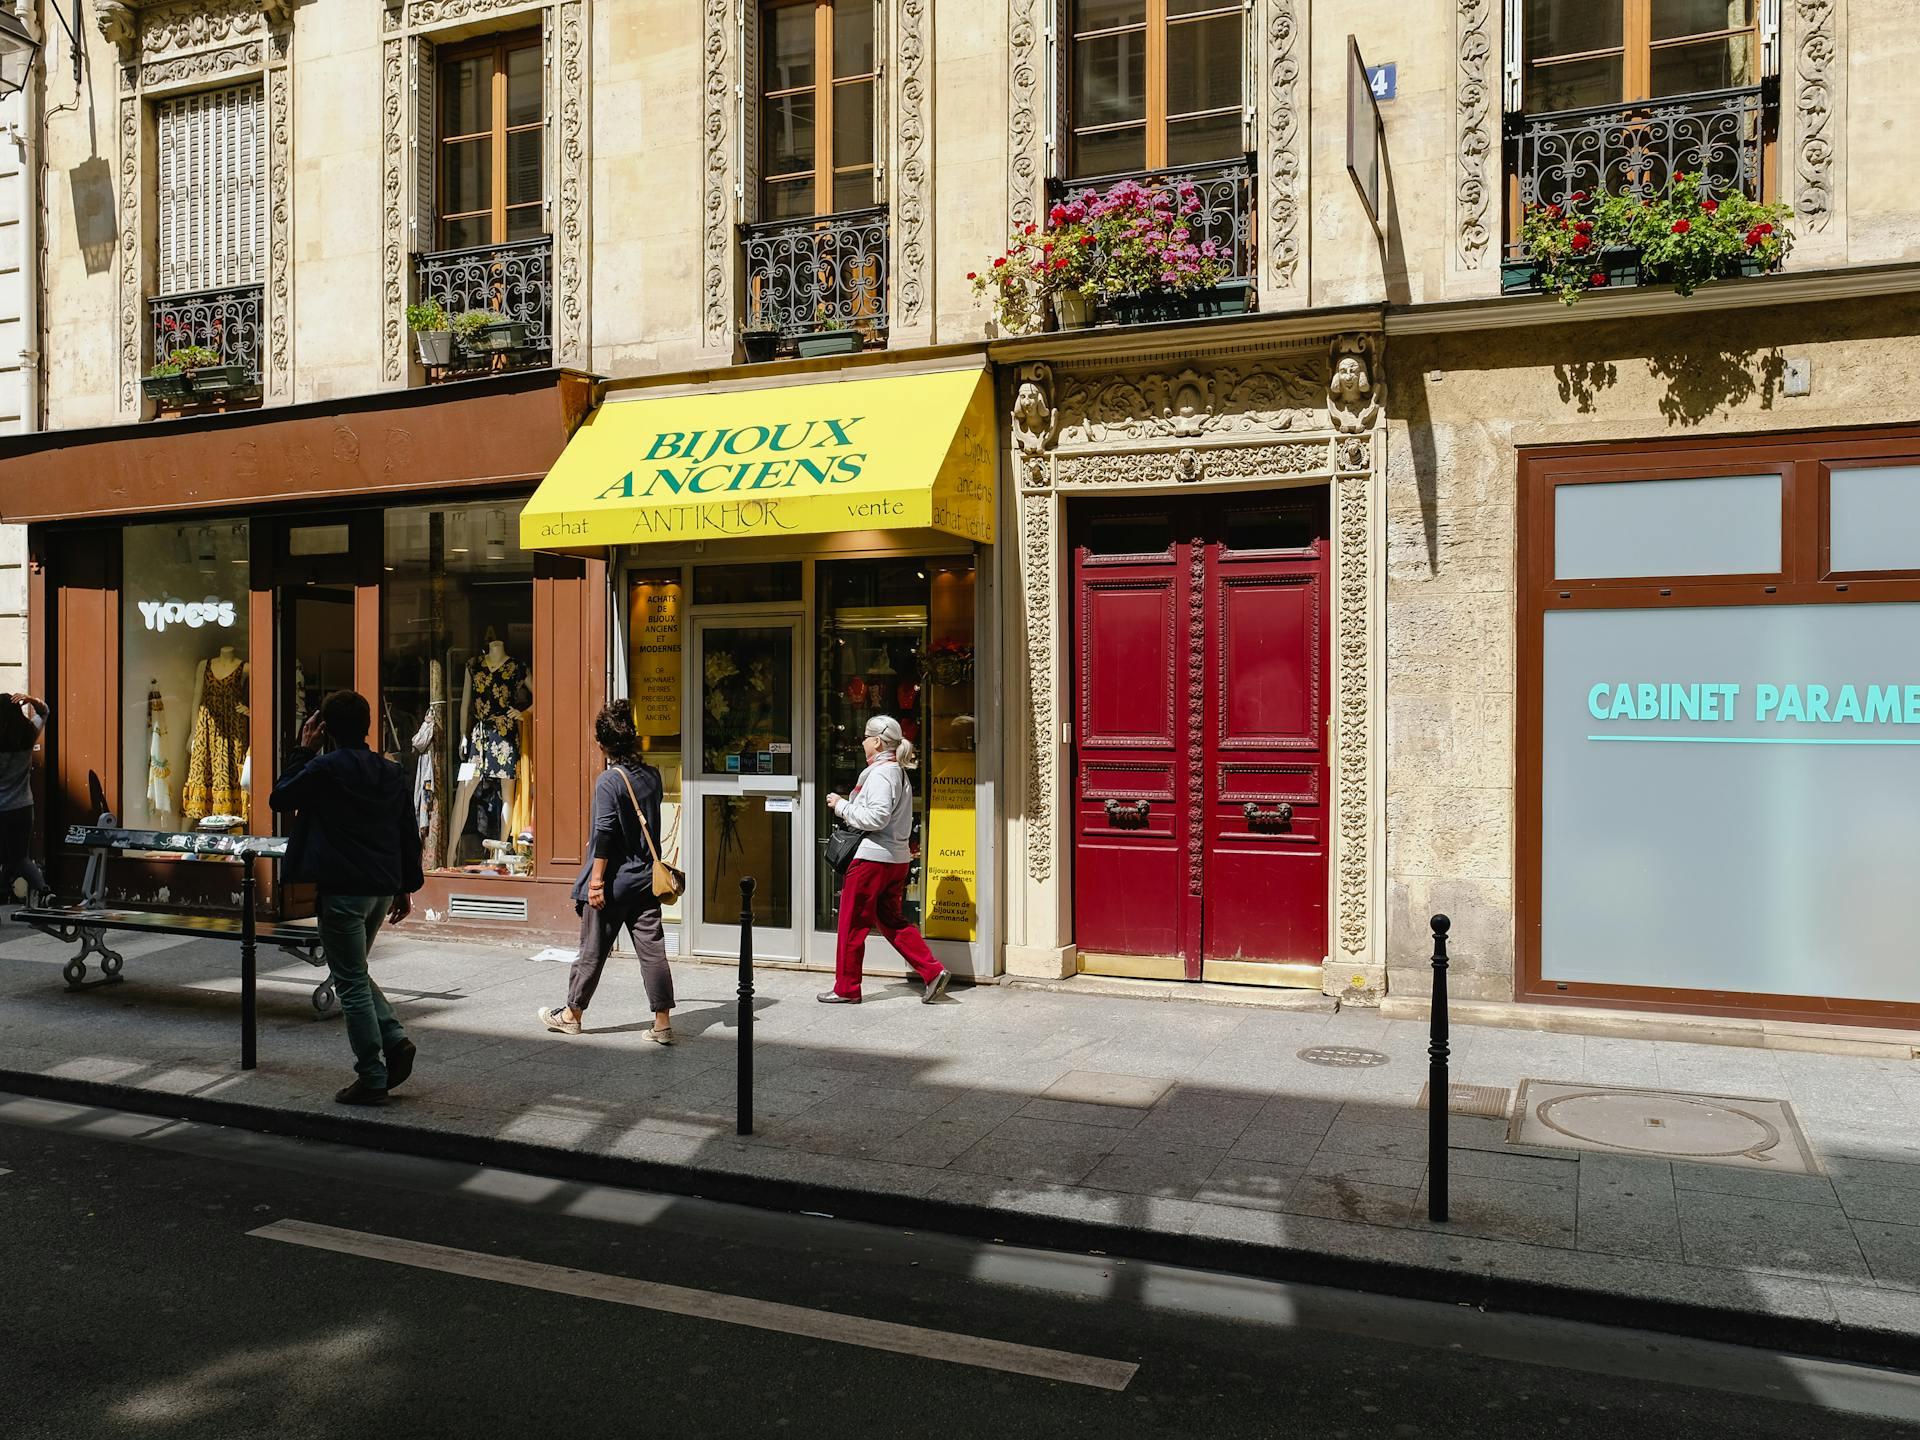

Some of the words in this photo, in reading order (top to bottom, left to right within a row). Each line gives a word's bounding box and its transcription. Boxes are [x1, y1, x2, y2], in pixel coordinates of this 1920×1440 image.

[1371, 69, 1388, 96] 4
[640, 416, 866, 464] BIJOUX
[964, 426, 991, 466] Bijoux
[594, 453, 867, 500] ANCIENS
[957, 473, 992, 503] anciens
[541, 512, 589, 536] achat
[632, 501, 799, 534] ANTIKHOR
[848, 498, 905, 517] vente
[934, 498, 961, 530] achat
[647, 594, 677, 603] ACHATS
[657, 605, 667, 613] DE
[648, 615, 676, 623] BIJOUX
[645, 625, 678, 633] ANCIENS
[639, 645, 682, 653] MODERNES
[1588, 682, 1741, 721] CABINET
[1756, 683, 1920, 724] PARAME
[939, 849, 966, 857] ACHAT
[929, 867, 949, 875] Bijoux
[950, 868, 975, 876] anciens
[940, 875, 972, 883] modernes
[931, 899, 960, 908] Création
[933, 906, 955, 915] bijoux
[931, 914, 969, 922] commande
